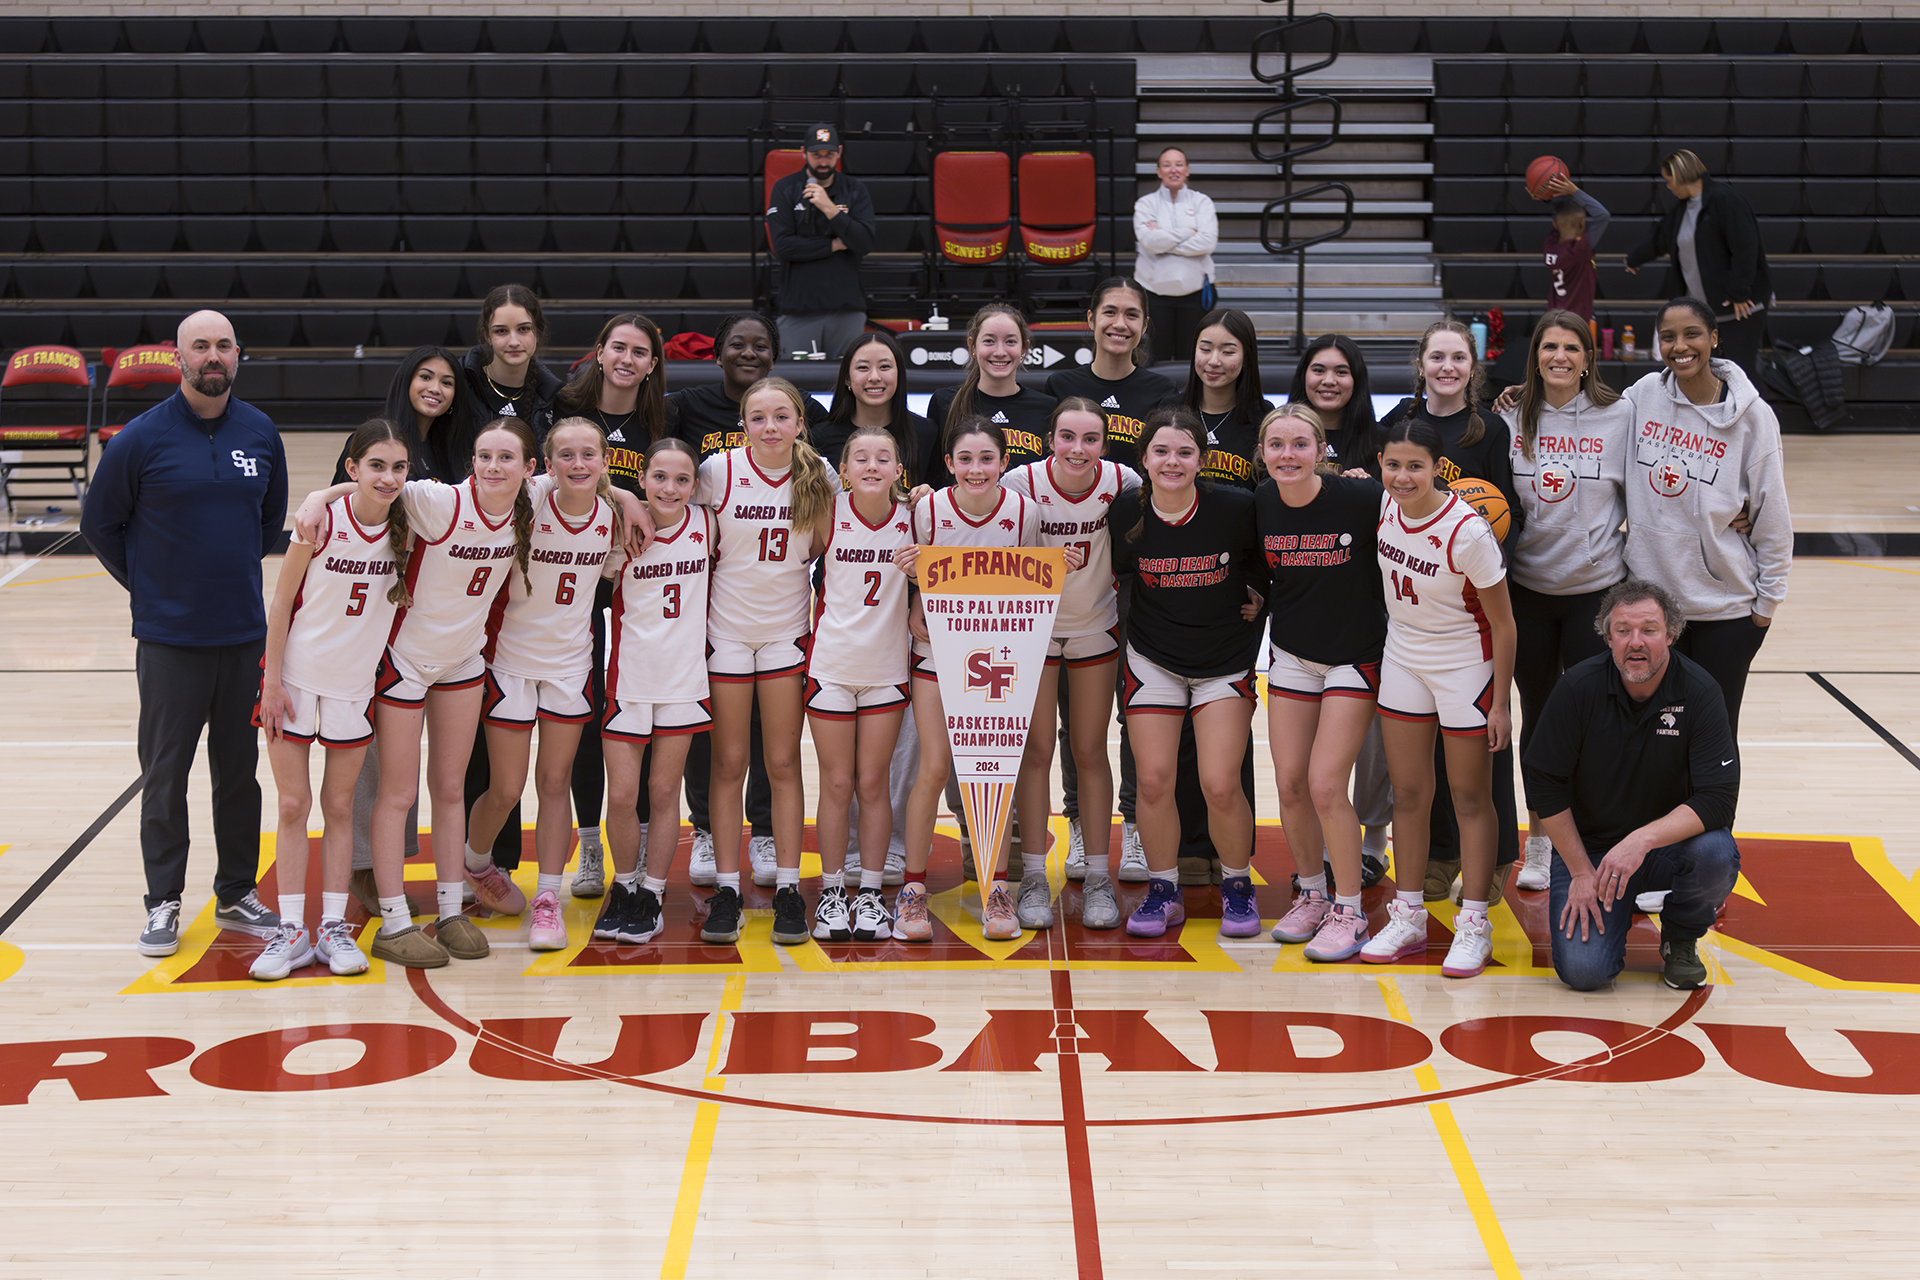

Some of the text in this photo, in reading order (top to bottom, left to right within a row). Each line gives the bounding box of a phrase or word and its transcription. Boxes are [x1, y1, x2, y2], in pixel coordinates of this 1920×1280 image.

[14, 351, 81, 370] ST. FRANCIS
[119, 351, 177, 369] ST. FRANC
[928, 352, 952, 361] BONUS
[1641, 420, 1663, 440] ST.
[1539, 436, 1604, 454] FRANCIS
[231, 450, 258, 477] SH
[606, 447, 645, 472] RANC
[1541, 470, 1567, 495] SF
[734, 504, 776, 520] SACRED
[1040, 520, 1078, 536] SACRED
[758, 527, 789, 562] 13
[1264, 533, 1339, 550] SACRED HEART
[448, 544, 519, 560] SACRED HEAR
[531, 548, 607, 566] SACRED HEART
[835, 547, 875, 563] SACRED
[1281, 547, 1351, 567] BASKETBALL
[1378, 538, 1440, 577] SACRED HEART
[325, 556, 395, 576] SACRED HEAR
[633, 557, 707, 580] SACRED HEART
[927, 550, 1053, 589] ST. FRANCIS
[1139, 554, 1219, 573] SACRED HEART
[466, 566, 493, 597] 8
[1160, 565, 1230, 588] BASKETBALL
[555, 572, 577, 605] 6
[864, 571, 881, 607] 2
[1390, 569, 1419, 605] 14
[345, 582, 370, 616] 5
[663, 583, 681, 619] 3
[927, 599, 1054, 614] GIRLS PAL VARSITY
[947, 618, 1035, 632] TOURNAMENT
[964, 647, 1018, 703] SF
[948, 716, 1029, 731] BASKETBALL
[1656, 728, 1680, 736] PANTHERS
[953, 733, 1024, 747] CHAMPIONS
[975, 761, 1000, 772] 2024
